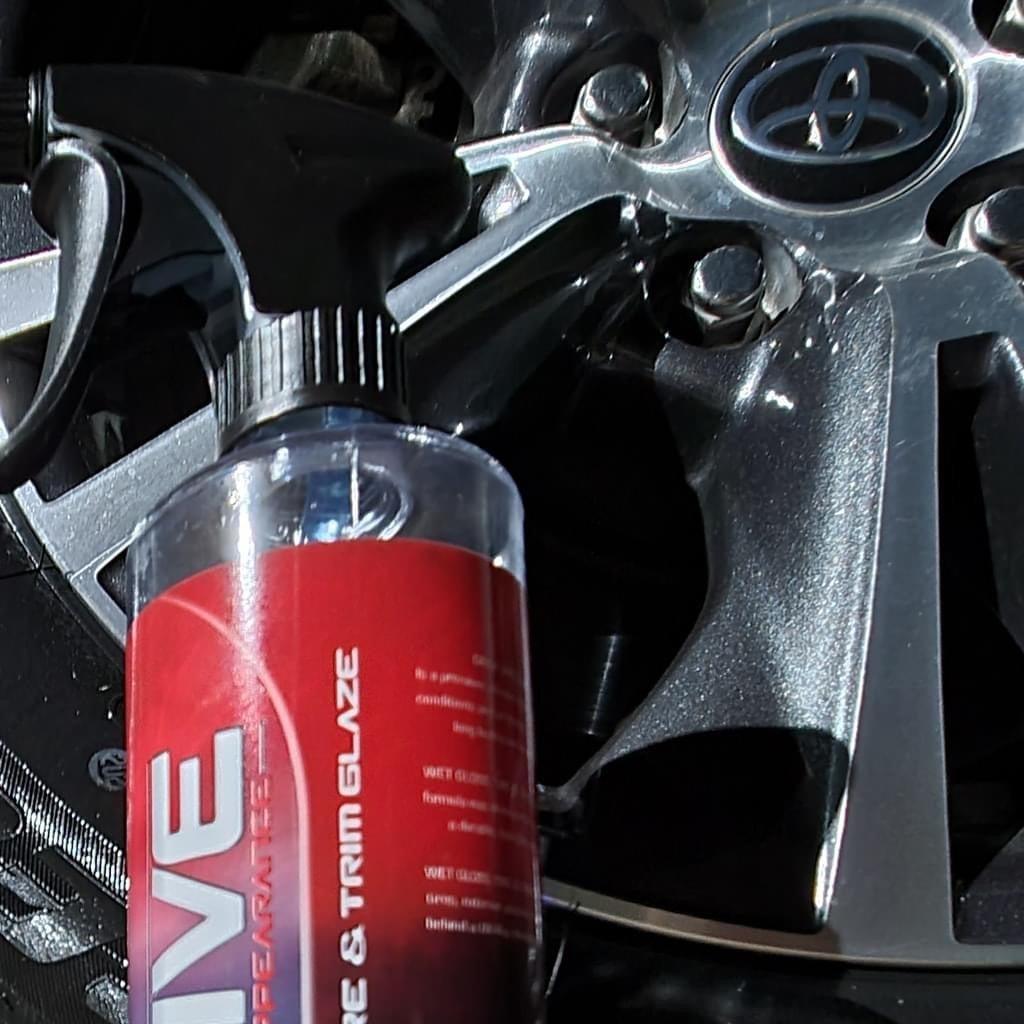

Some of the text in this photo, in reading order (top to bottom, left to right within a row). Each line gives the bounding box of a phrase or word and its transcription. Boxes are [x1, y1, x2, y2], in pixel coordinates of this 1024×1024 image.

[335, 647, 362, 797] GLAZE
[337, 803, 364, 919] TRIM
[339, 923, 367, 967] &
